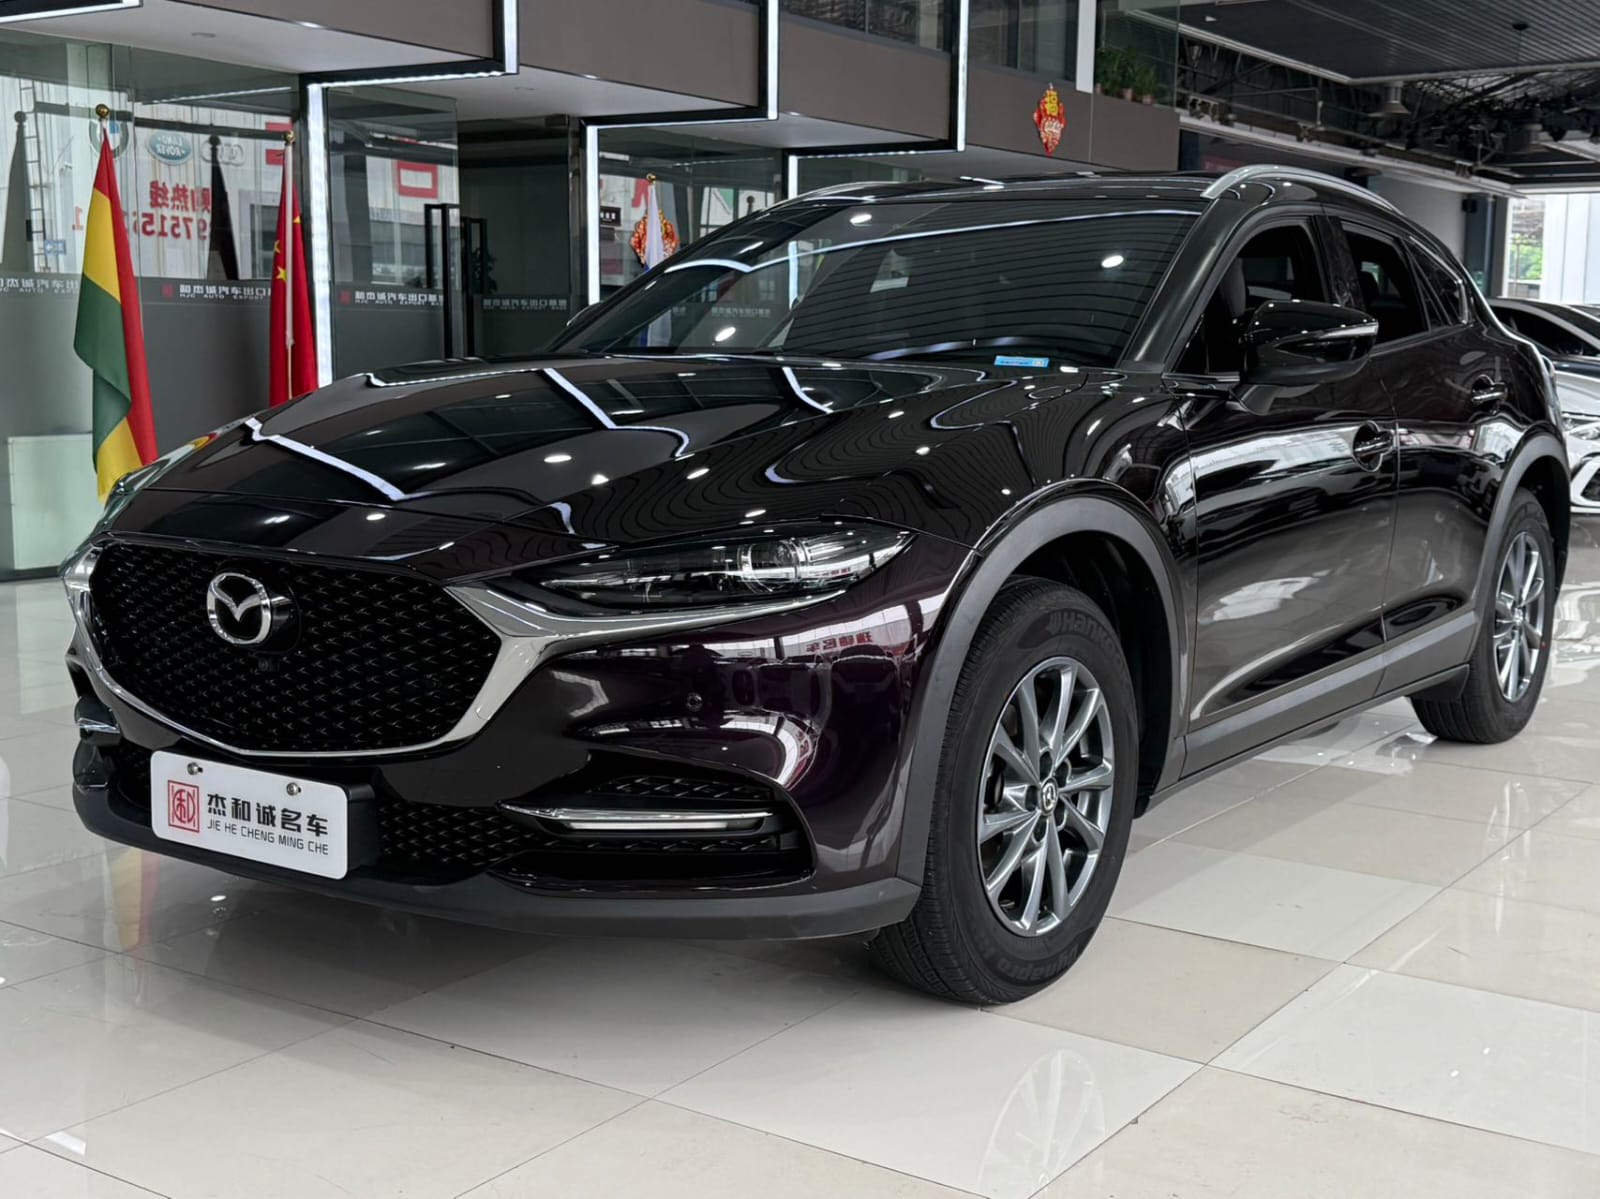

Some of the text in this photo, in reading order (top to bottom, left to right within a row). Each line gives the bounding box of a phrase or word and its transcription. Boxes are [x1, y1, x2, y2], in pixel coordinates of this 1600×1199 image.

[207, 793, 329, 838] 杰和诚名车
[207, 819, 329, 856] JIE HE CHENG MING CHE
